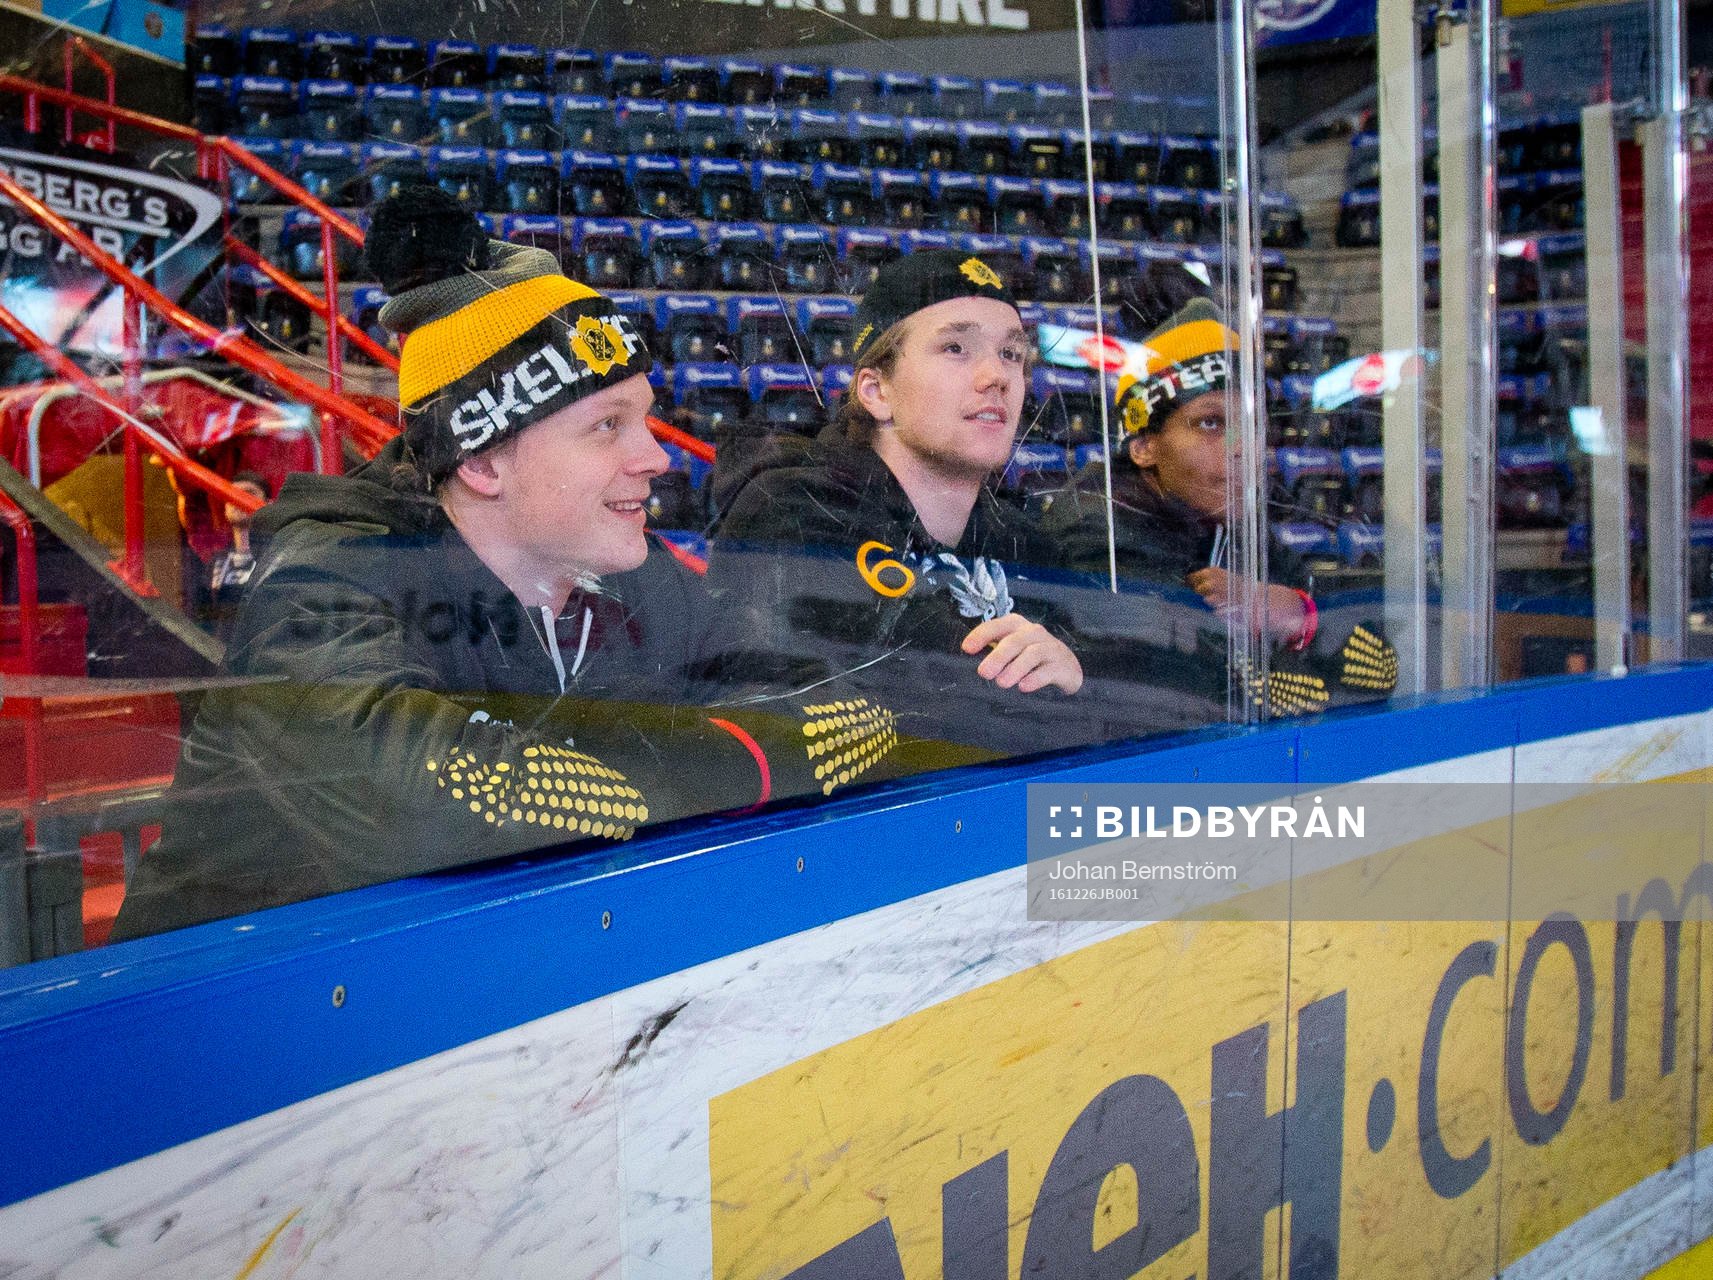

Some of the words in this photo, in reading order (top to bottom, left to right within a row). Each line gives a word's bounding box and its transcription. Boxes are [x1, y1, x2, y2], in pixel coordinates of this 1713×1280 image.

[0, 163, 170, 226] BERG´S
[0, 221, 43, 257] G
[450, 315, 638, 450] SKELF
[856, 540, 915, 598] 6
